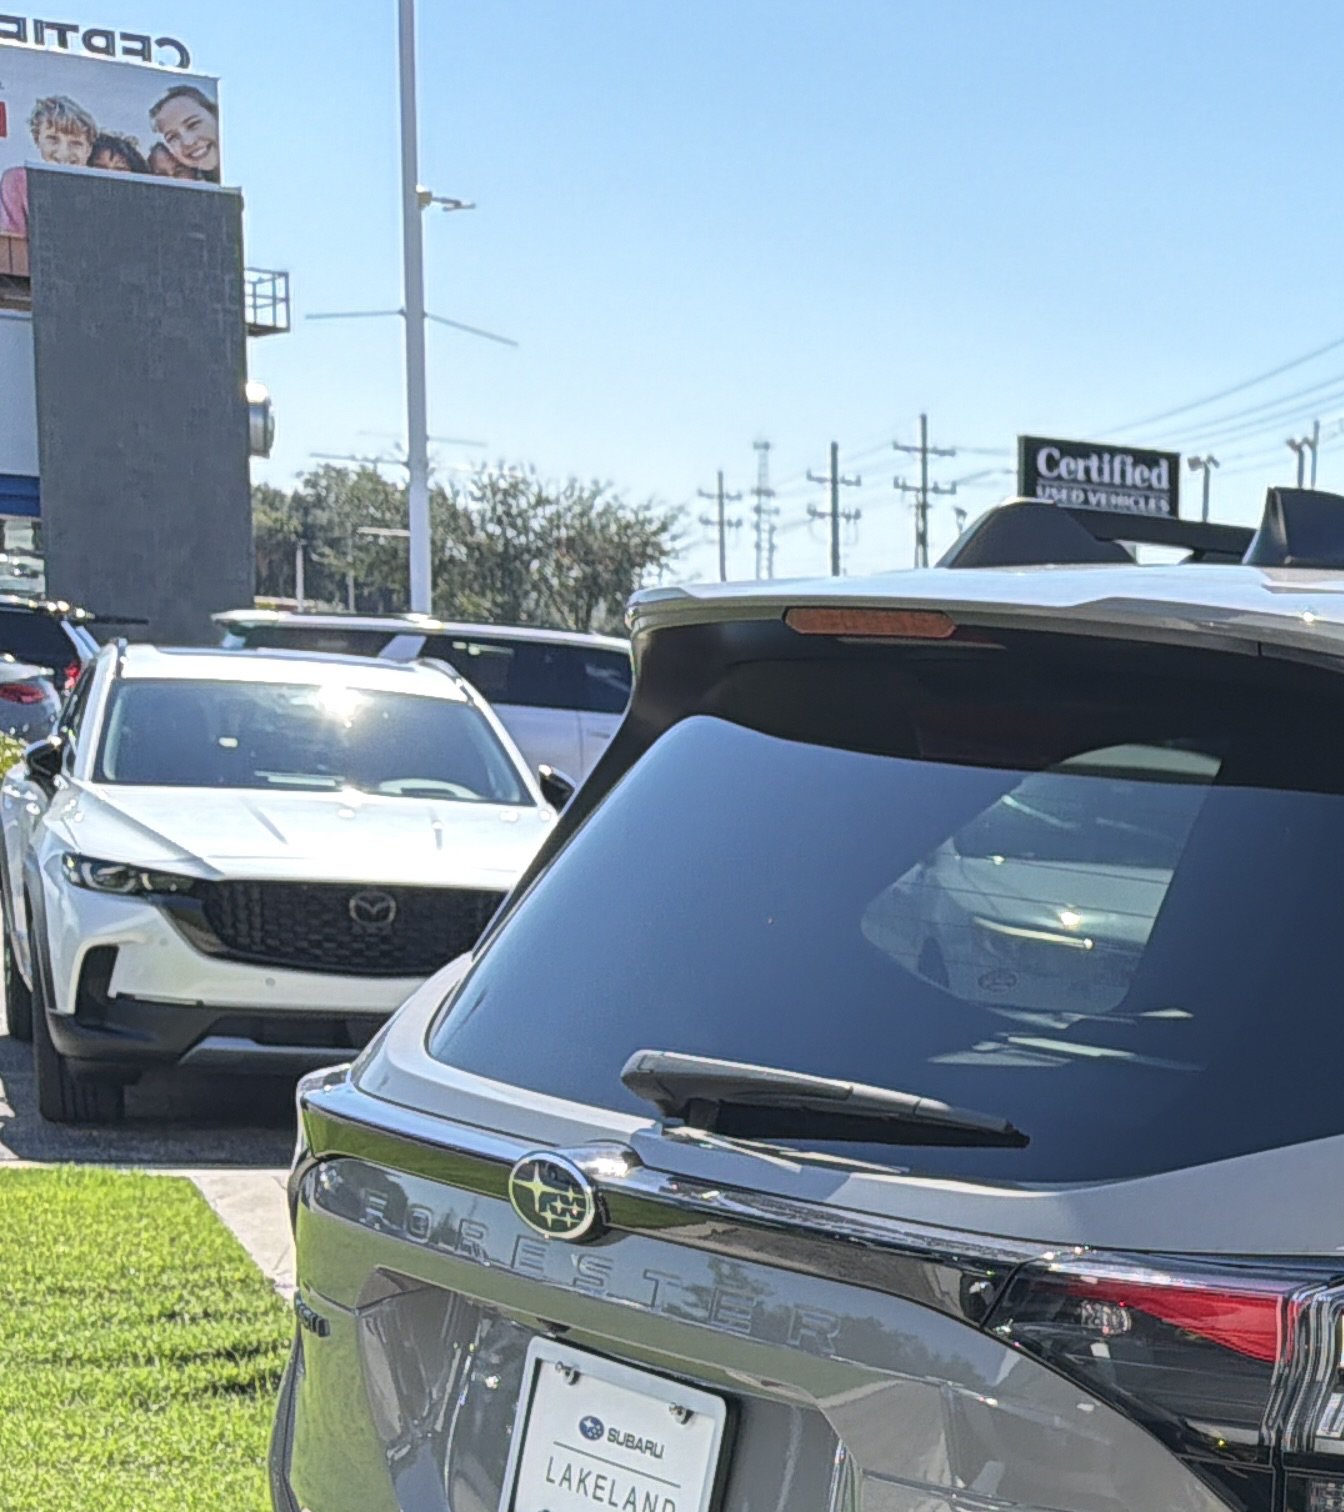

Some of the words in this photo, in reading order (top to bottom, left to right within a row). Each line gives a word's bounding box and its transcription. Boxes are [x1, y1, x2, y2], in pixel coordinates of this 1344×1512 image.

[1037, 447, 1170, 490] Certified
[362, 1187, 842, 1355] FORESTER
[607, 1427, 665, 1460] SUBARU
